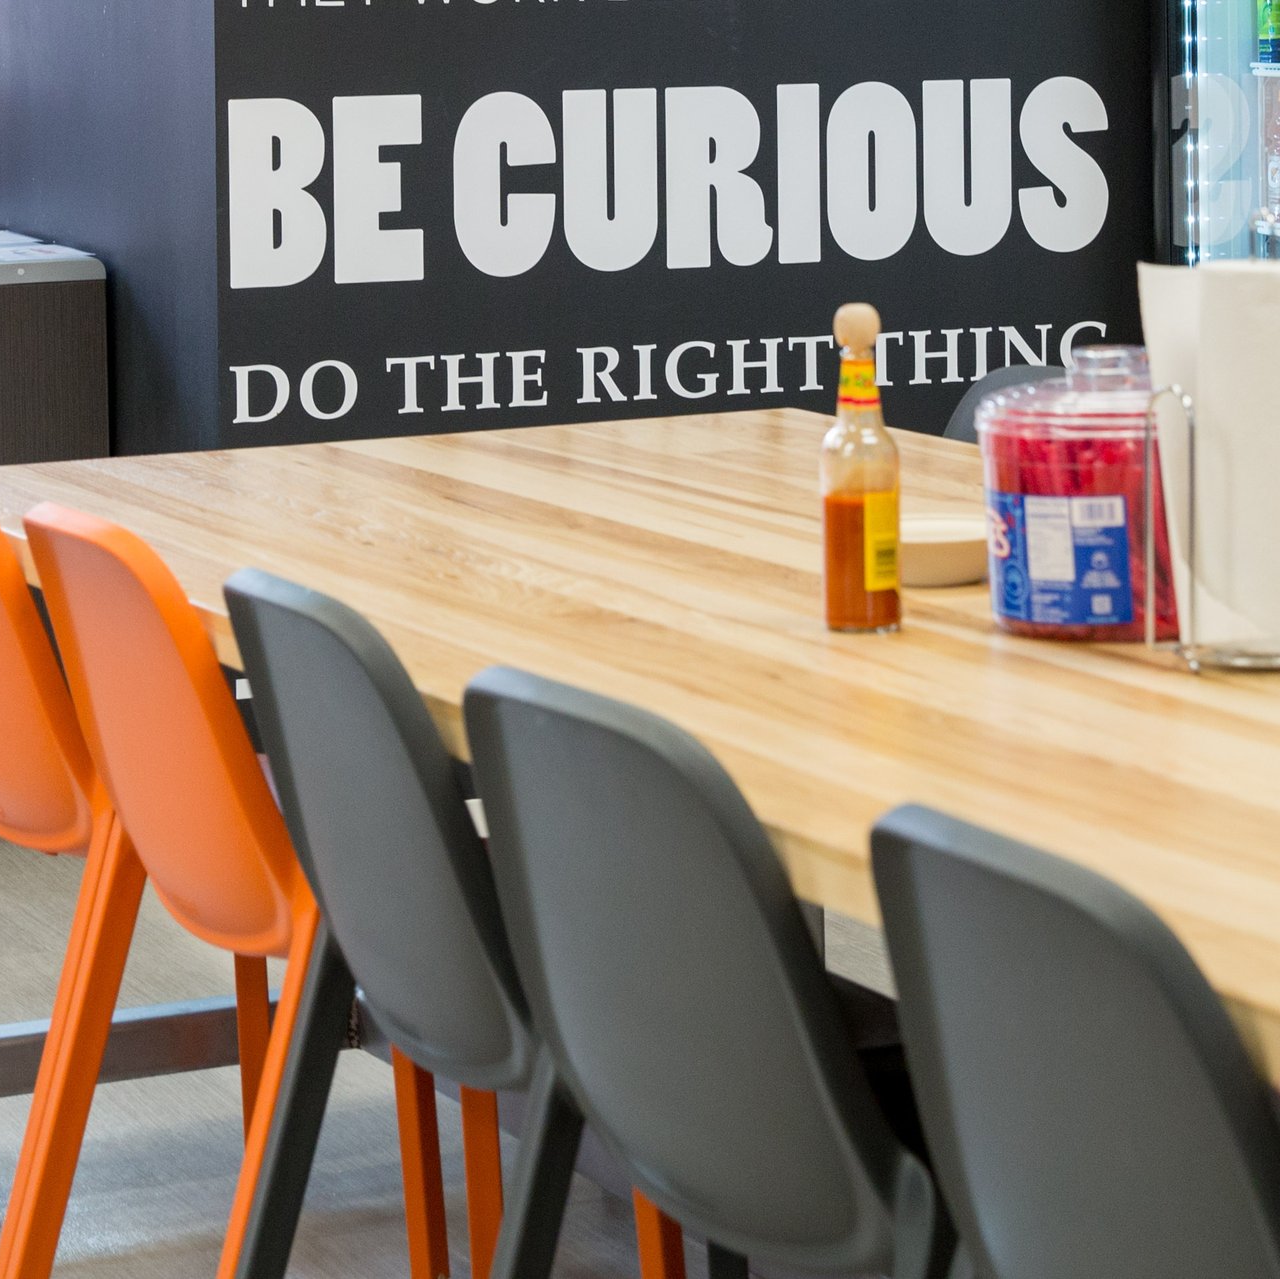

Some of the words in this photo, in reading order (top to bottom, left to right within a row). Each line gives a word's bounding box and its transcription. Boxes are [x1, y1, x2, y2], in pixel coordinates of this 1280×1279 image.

[227, 93, 425, 290] BE
[452, 75, 1110, 278] CURIOUS
[228, 359, 359, 424] DO
[385, 349, 548, 415] THE
[575, 334, 834, 405] RIGHT
